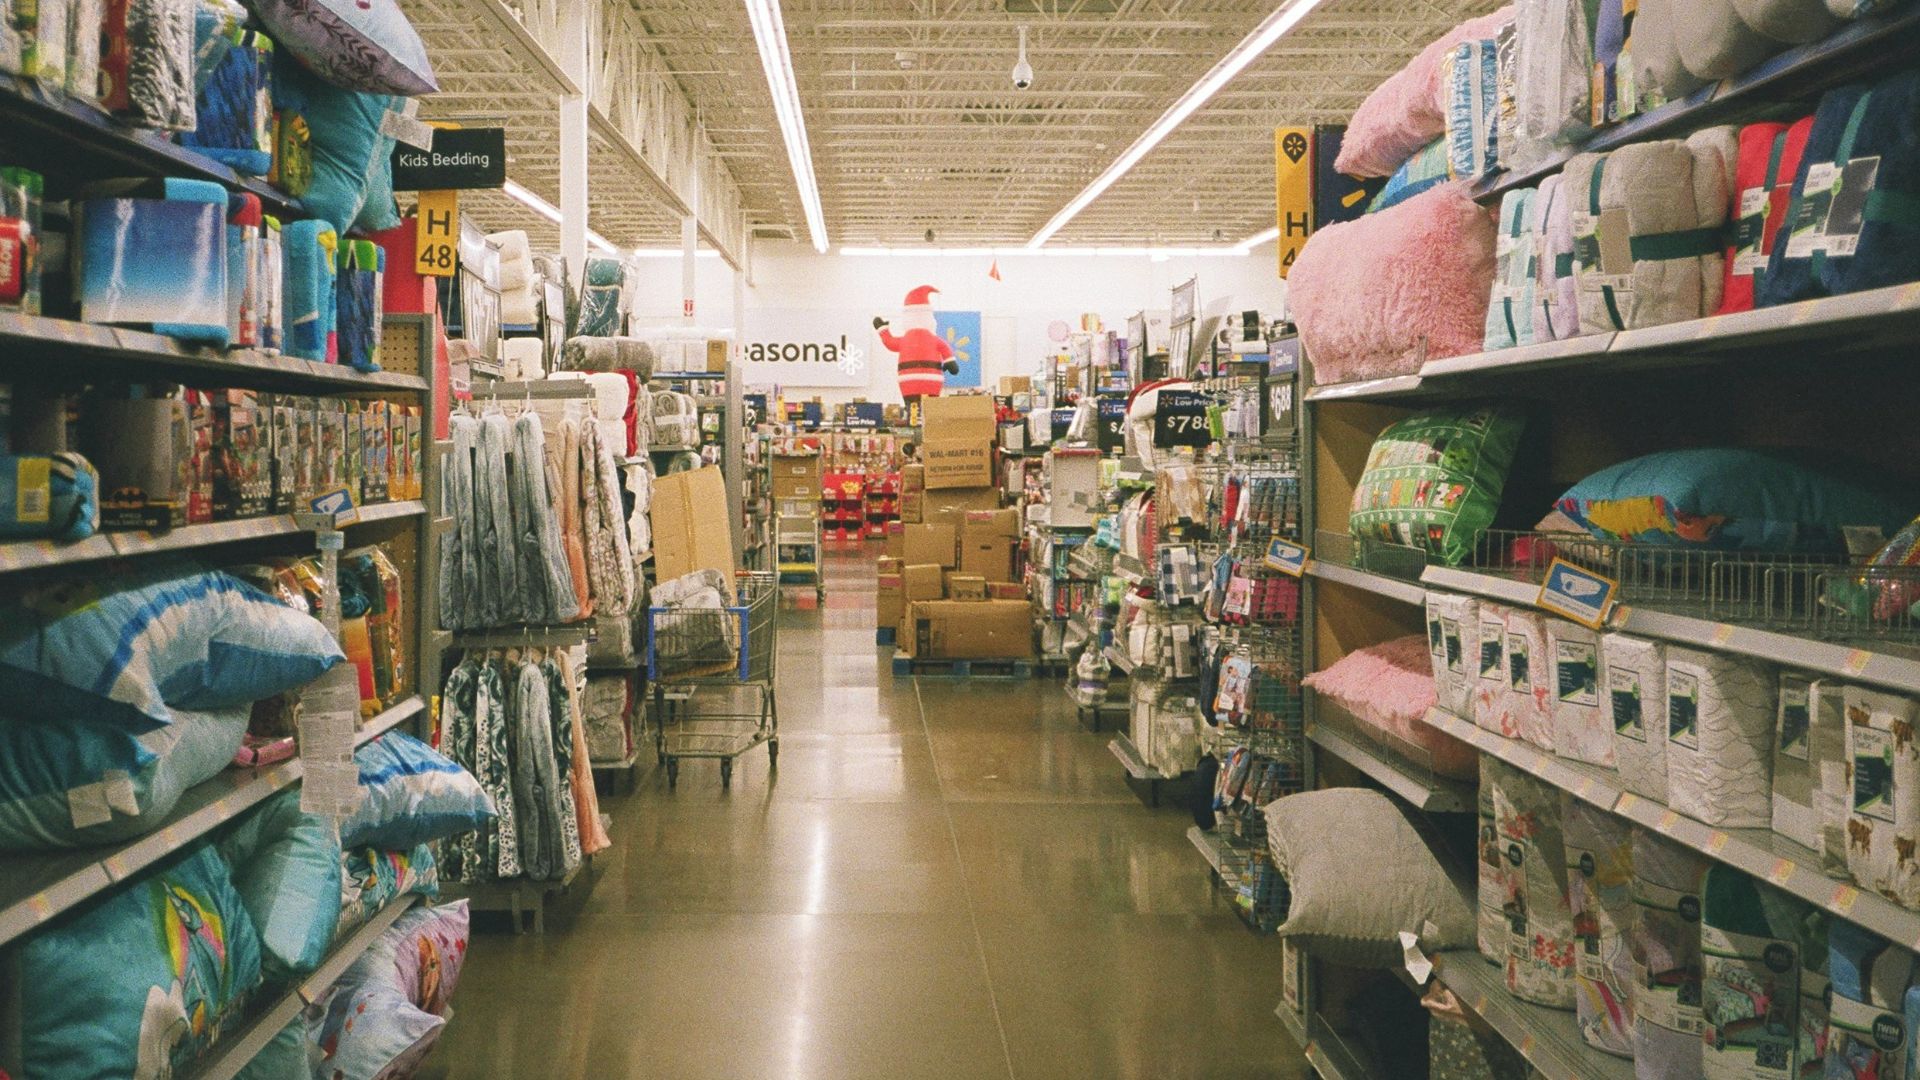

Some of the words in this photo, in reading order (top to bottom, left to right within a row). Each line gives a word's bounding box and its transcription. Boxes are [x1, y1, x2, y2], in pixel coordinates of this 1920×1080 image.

[400, 153, 428, 167] Kids
[432, 153, 490, 168] Bedding
[427, 209, 450, 236] H
[1286, 211, 1308, 237] H
[420, 244, 451, 268] 48
[1283, 247, 1296, 266] 4
[1876, 1022, 1900, 1036] TWIN
